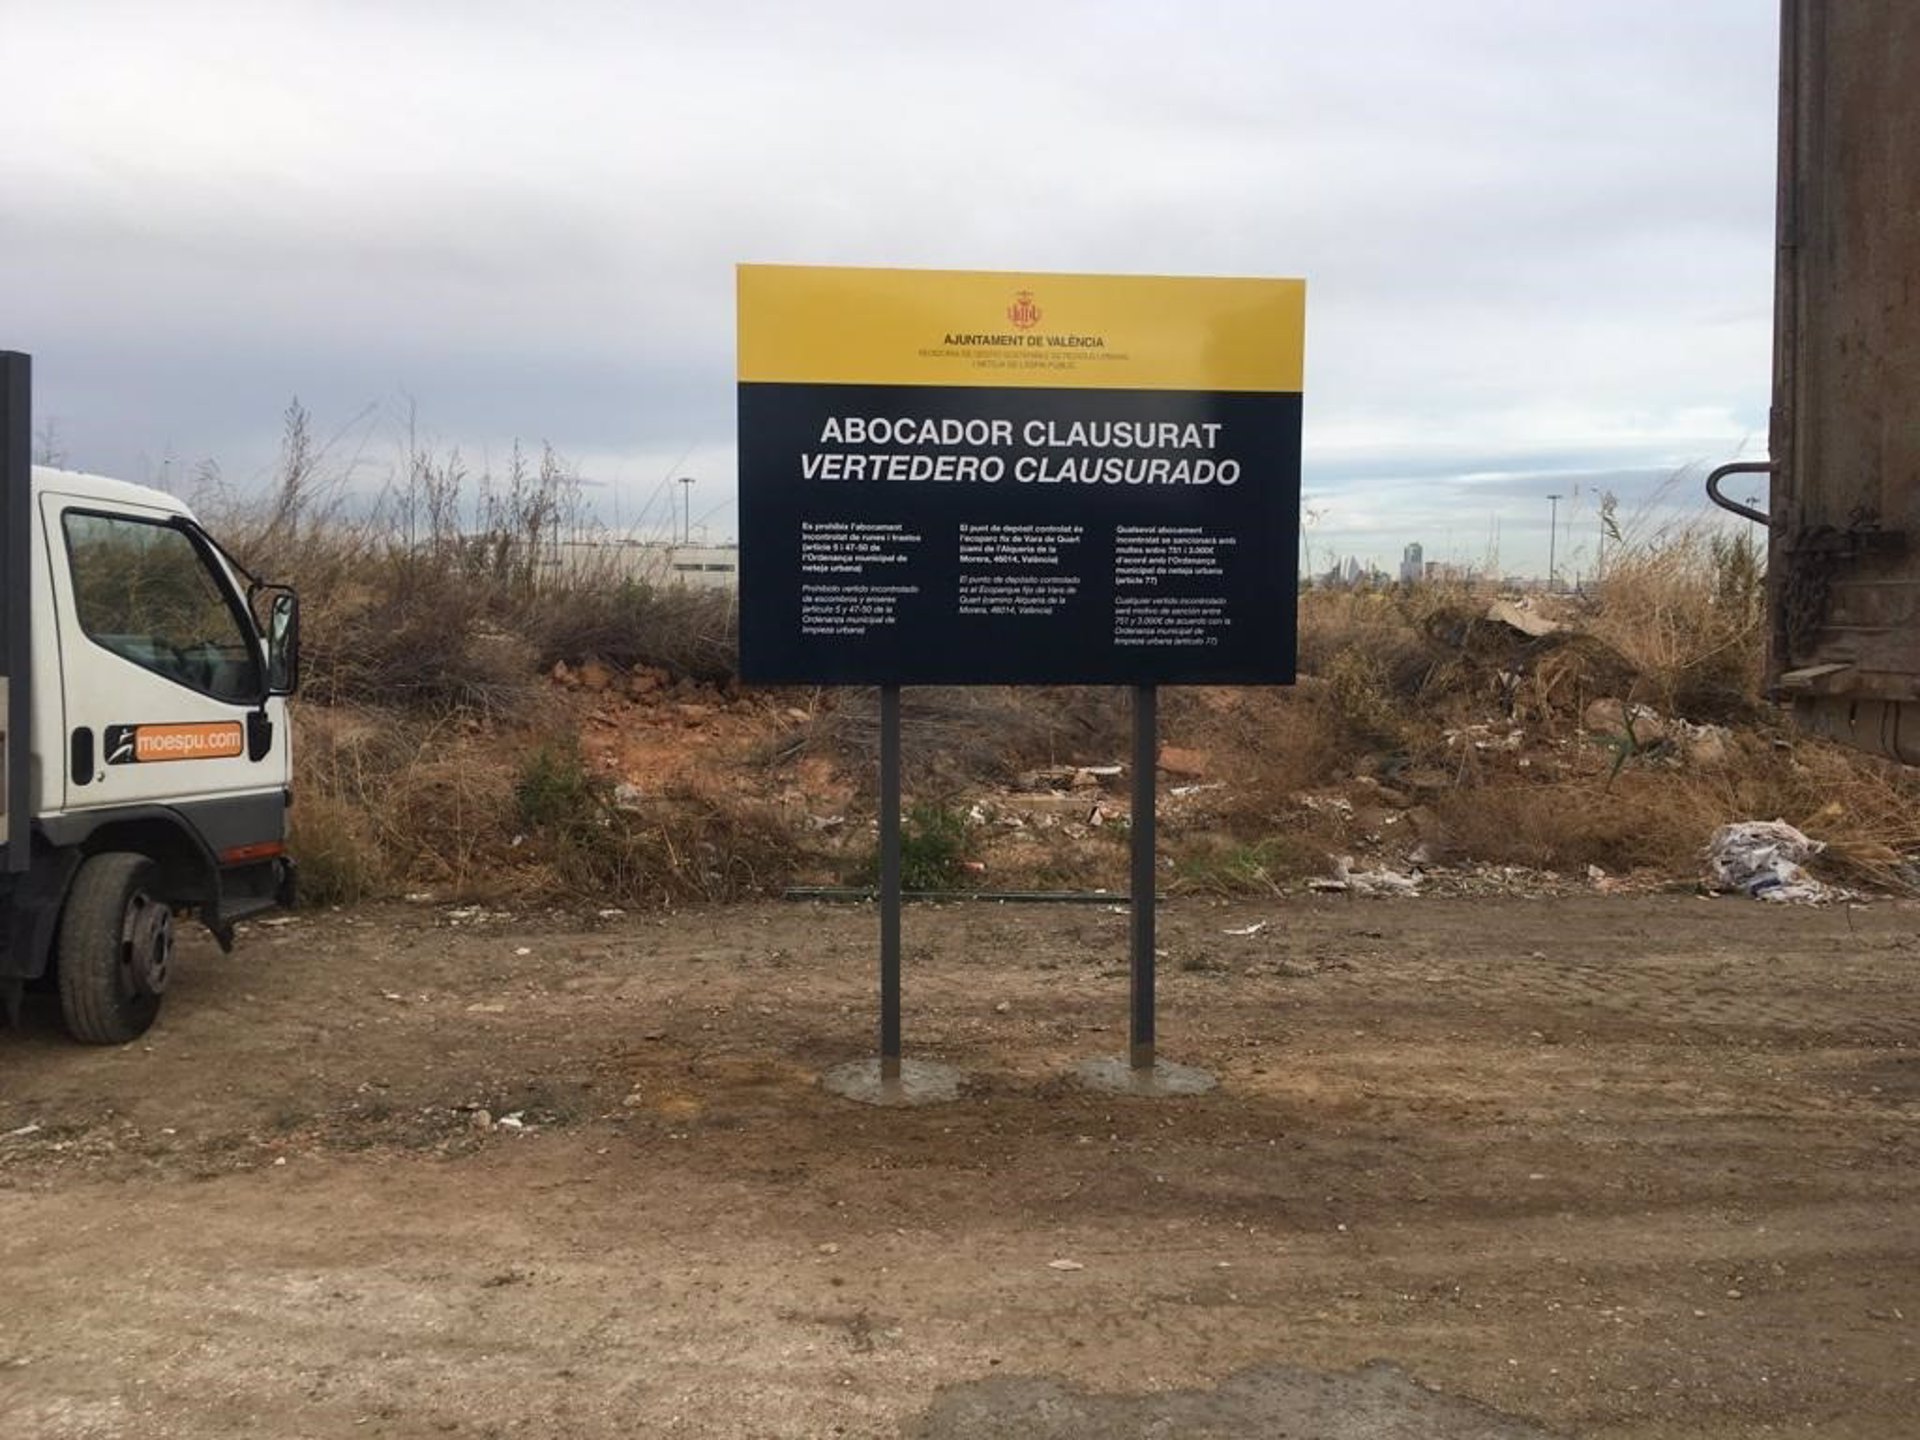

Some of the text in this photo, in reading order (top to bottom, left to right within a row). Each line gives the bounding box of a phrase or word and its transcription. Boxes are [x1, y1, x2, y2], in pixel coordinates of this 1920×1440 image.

[944, 334, 1104, 347] AJUNTAMENT DE VALÈNCIA
[820, 417, 1222, 449] ABOCADOR CLAUSURAT
[800, 454, 1240, 485] VERTEDERO CLAUSURADO
[1035, 525, 1071, 533] controlat
[855, 555, 894, 564] municipal
[1115, 567, 1155, 575] municipal
[960, 596, 981, 604] Quart
[846, 616, 883, 625] municipal
[137, 732, 240, 754] moespu.com
